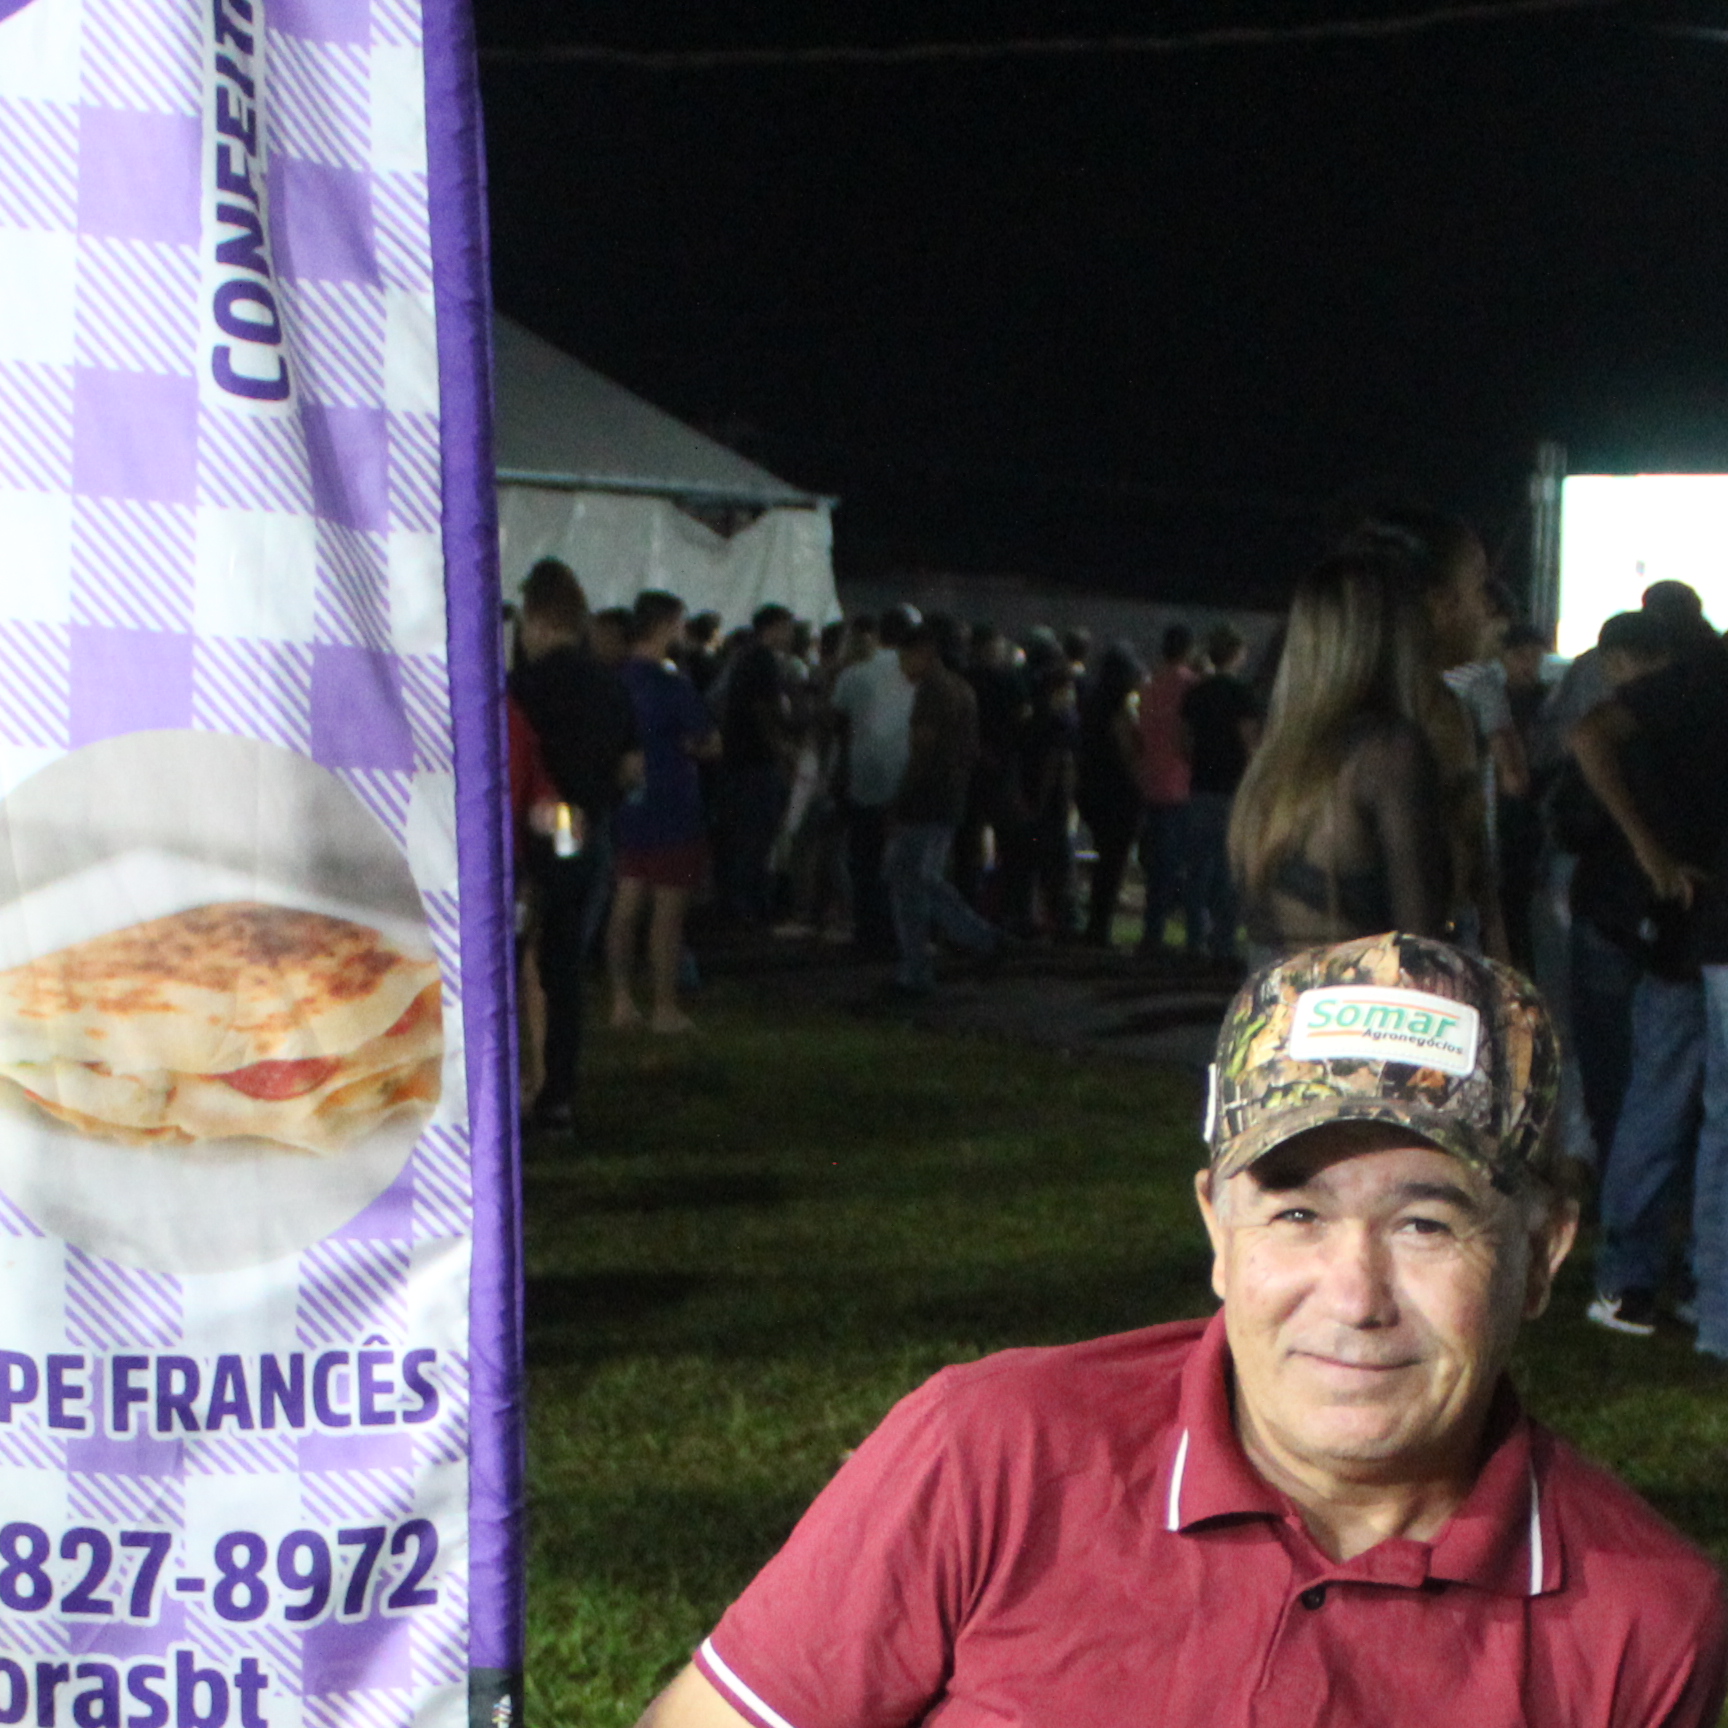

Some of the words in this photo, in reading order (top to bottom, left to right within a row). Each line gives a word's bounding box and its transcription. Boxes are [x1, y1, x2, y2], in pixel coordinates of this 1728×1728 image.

[1308, 999, 1456, 1038] Somar
[1362, 1028, 1463, 1055] Agronegócios
[112, 1334, 440, 1432] FRANCÊS
